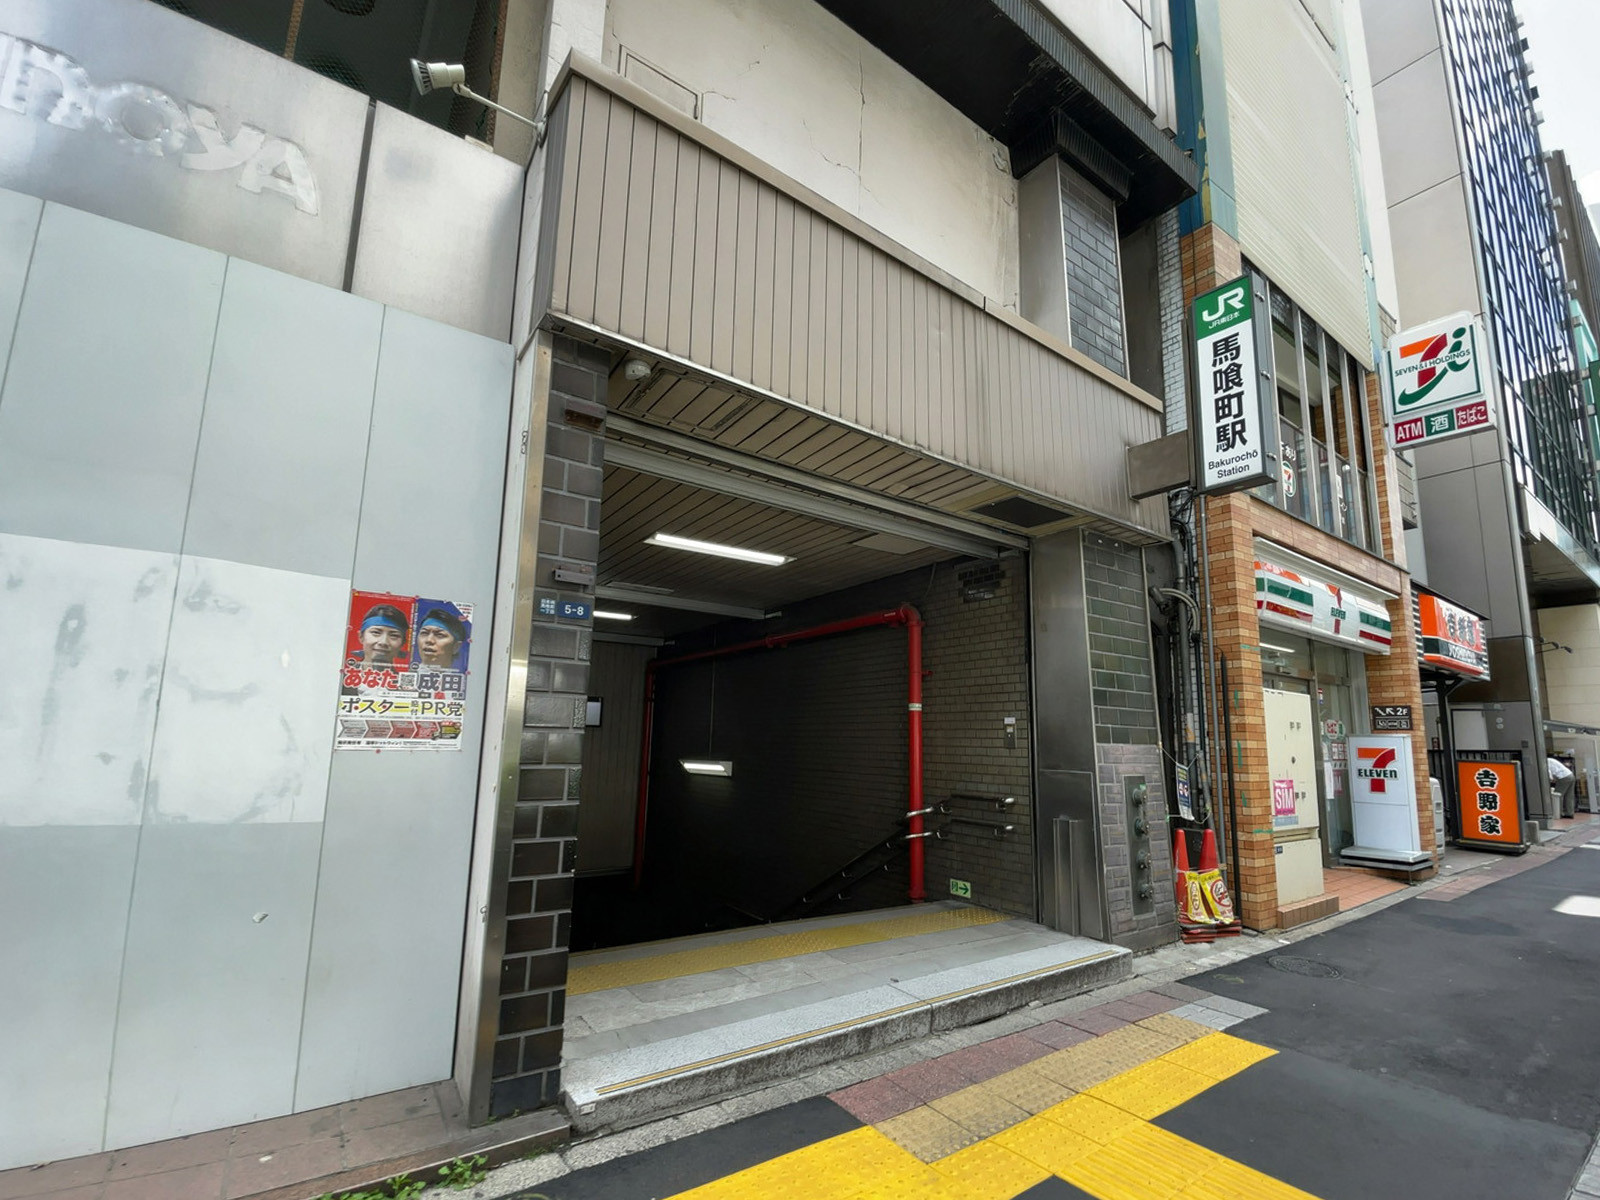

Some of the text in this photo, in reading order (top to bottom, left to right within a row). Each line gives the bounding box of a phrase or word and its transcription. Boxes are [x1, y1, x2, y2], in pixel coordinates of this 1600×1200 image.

[1202, 286, 1245, 322] JR
[1208, 311, 1240, 329] JR東日本
[1429, 349, 1471, 366] HOLDINGS
[1211, 332, 1248, 453] 馬喰町駅
[1430, 414, 1449, 433] 酒
[1457, 405, 1487, 426] たばこ
[1397, 421, 1422, 441] ATM
[1217, 464, 1250, 479] Station
[564, 604, 584, 616] 5-8
[344, 667, 399, 690] あなた
[417, 671, 462, 692] 成田
[1396, 707, 1408, 716] 2F
[1275, 787, 1294, 810] SIM
[1475, 768, 1502, 835] 吉野家
